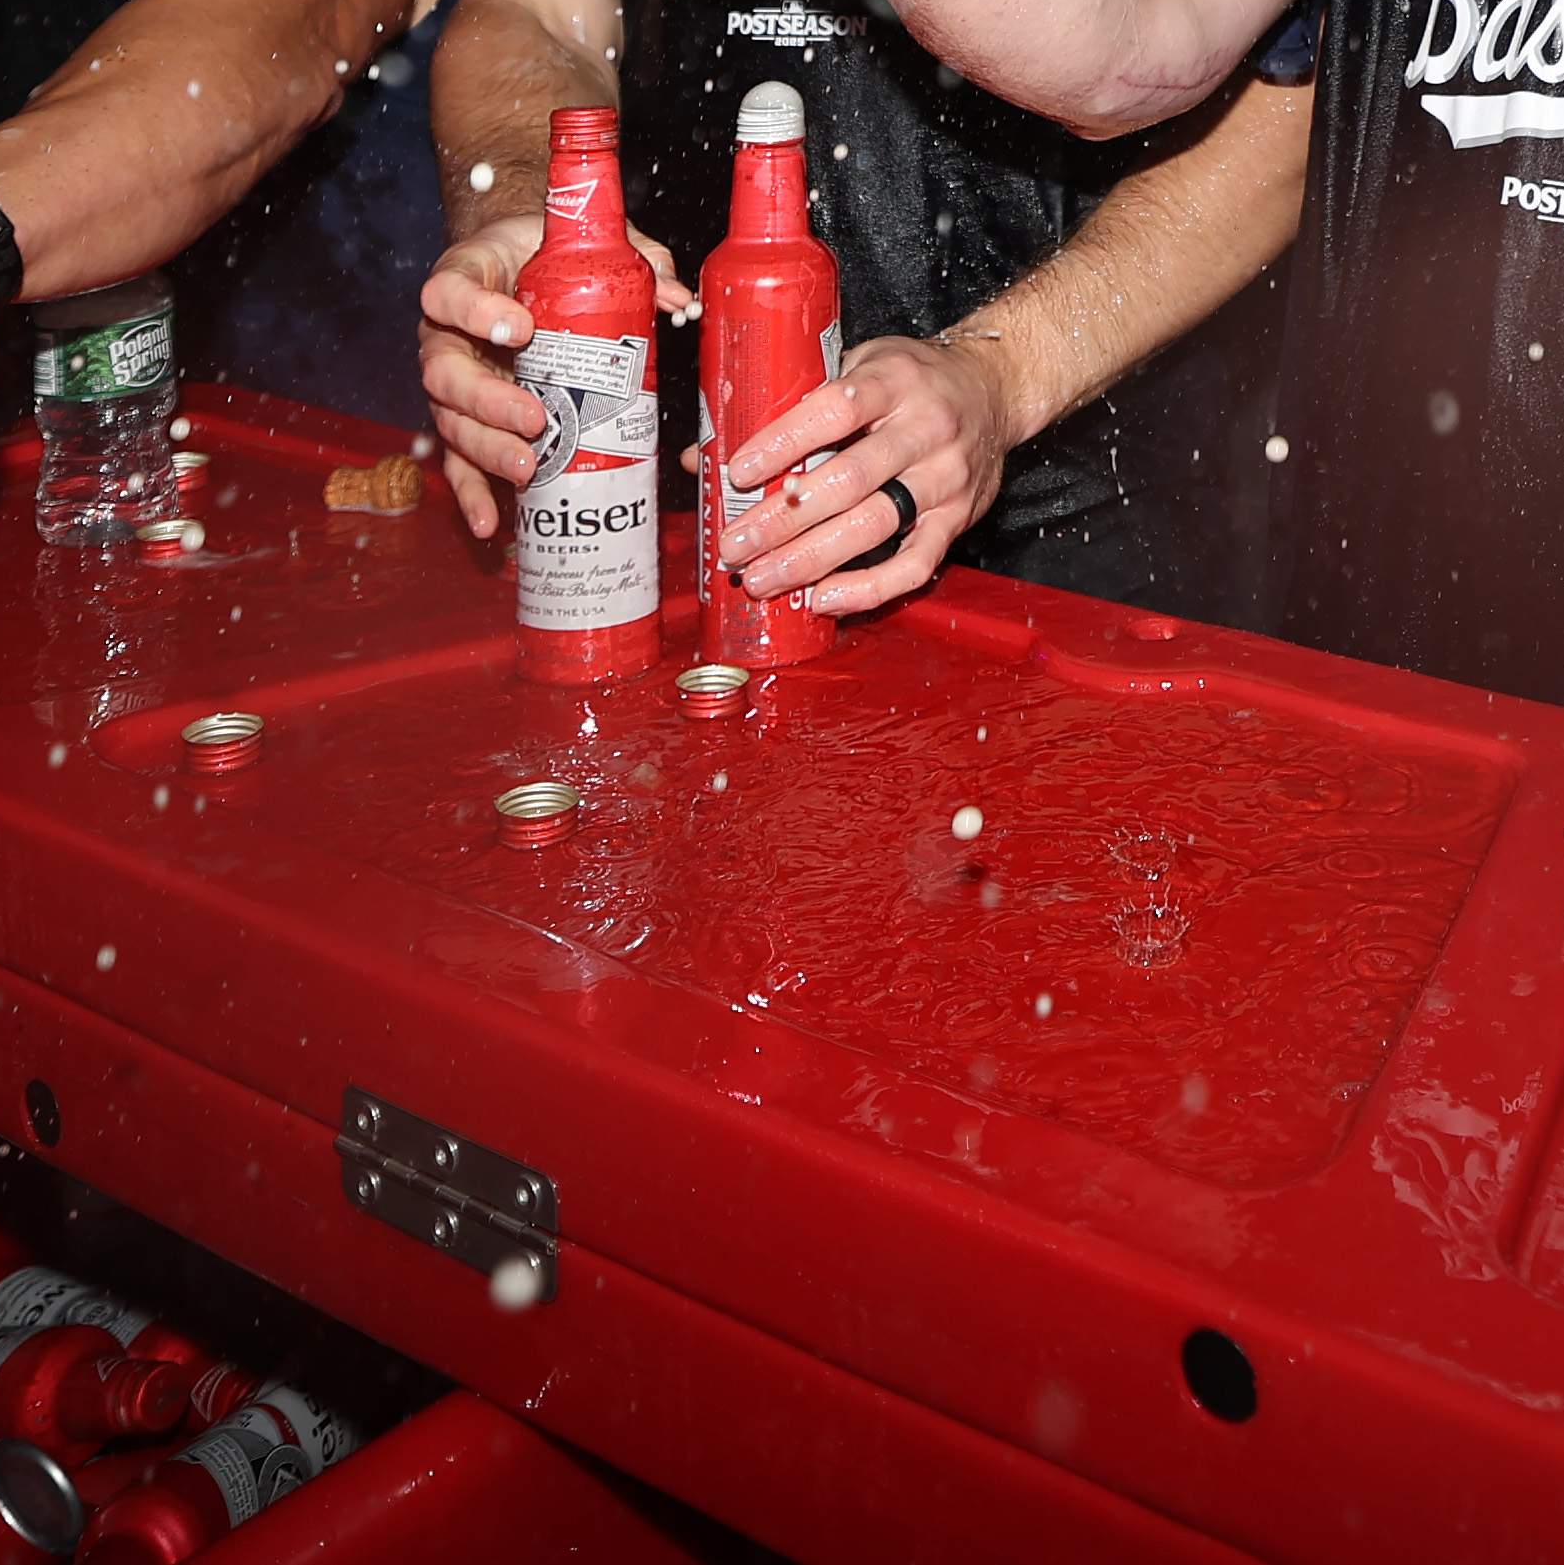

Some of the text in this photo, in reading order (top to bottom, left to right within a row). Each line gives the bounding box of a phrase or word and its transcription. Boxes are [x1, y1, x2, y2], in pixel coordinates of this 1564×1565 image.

[727, 10, 867, 36] POSTSEASON
[109, 315, 172, 386] Poland Spring
